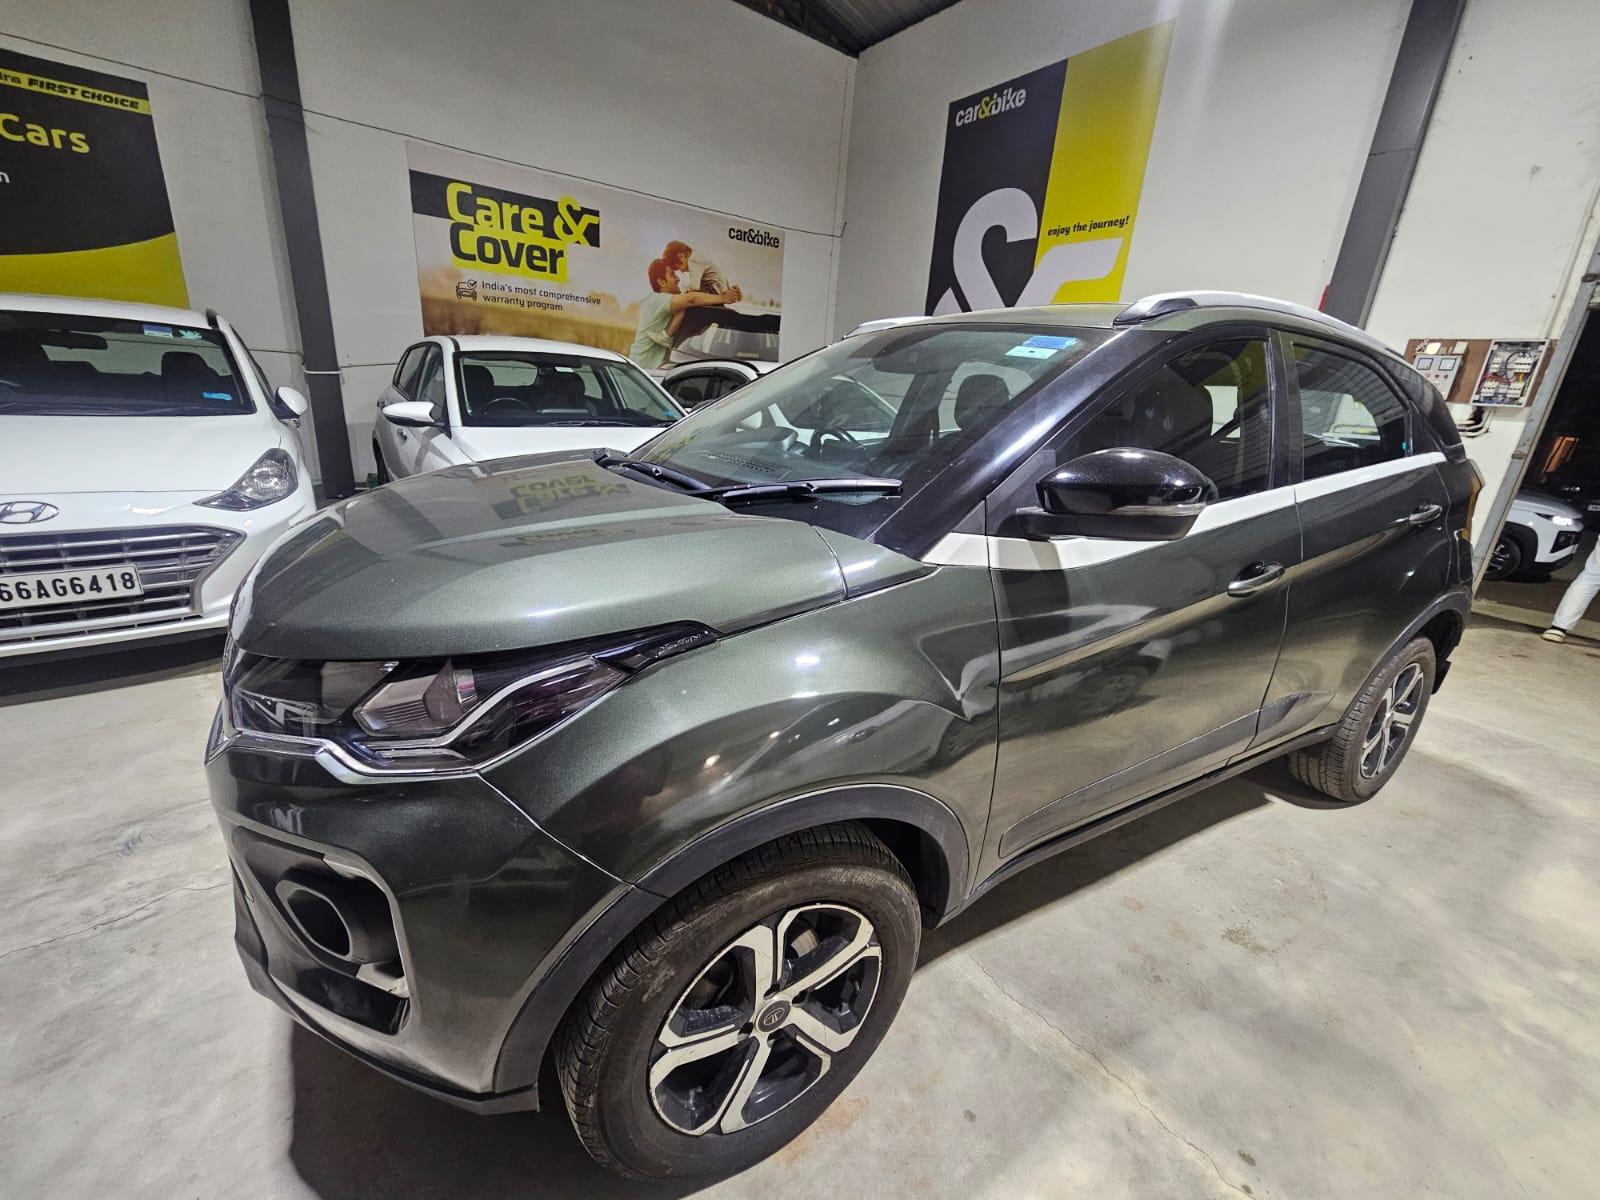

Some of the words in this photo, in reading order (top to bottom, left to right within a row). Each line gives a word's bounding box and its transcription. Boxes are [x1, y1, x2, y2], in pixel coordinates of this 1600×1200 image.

[27, 78, 79, 96] FIRST
[80, 90, 140, 110] CHOICE
[955, 87, 1027, 127] car&bike
[0, 112, 90, 154] Cars
[446, 182, 545, 238] Care
[553, 194, 600, 247] &
[1047, 225, 1071, 237] enjoy
[1073, 221, 1088, 233] the
[1088, 215, 1130, 232] journey!
[450, 221, 565, 275] Cover
[728, 227, 780, 249] car&bike
[482, 280, 513, 294] India's
[514, 286, 537, 297] most
[538, 288, 601, 306] comprehensive
[482, 293, 525, 308] warranty
[526, 299, 564, 312] program
[0, 571, 136, 602] 66AG6418
